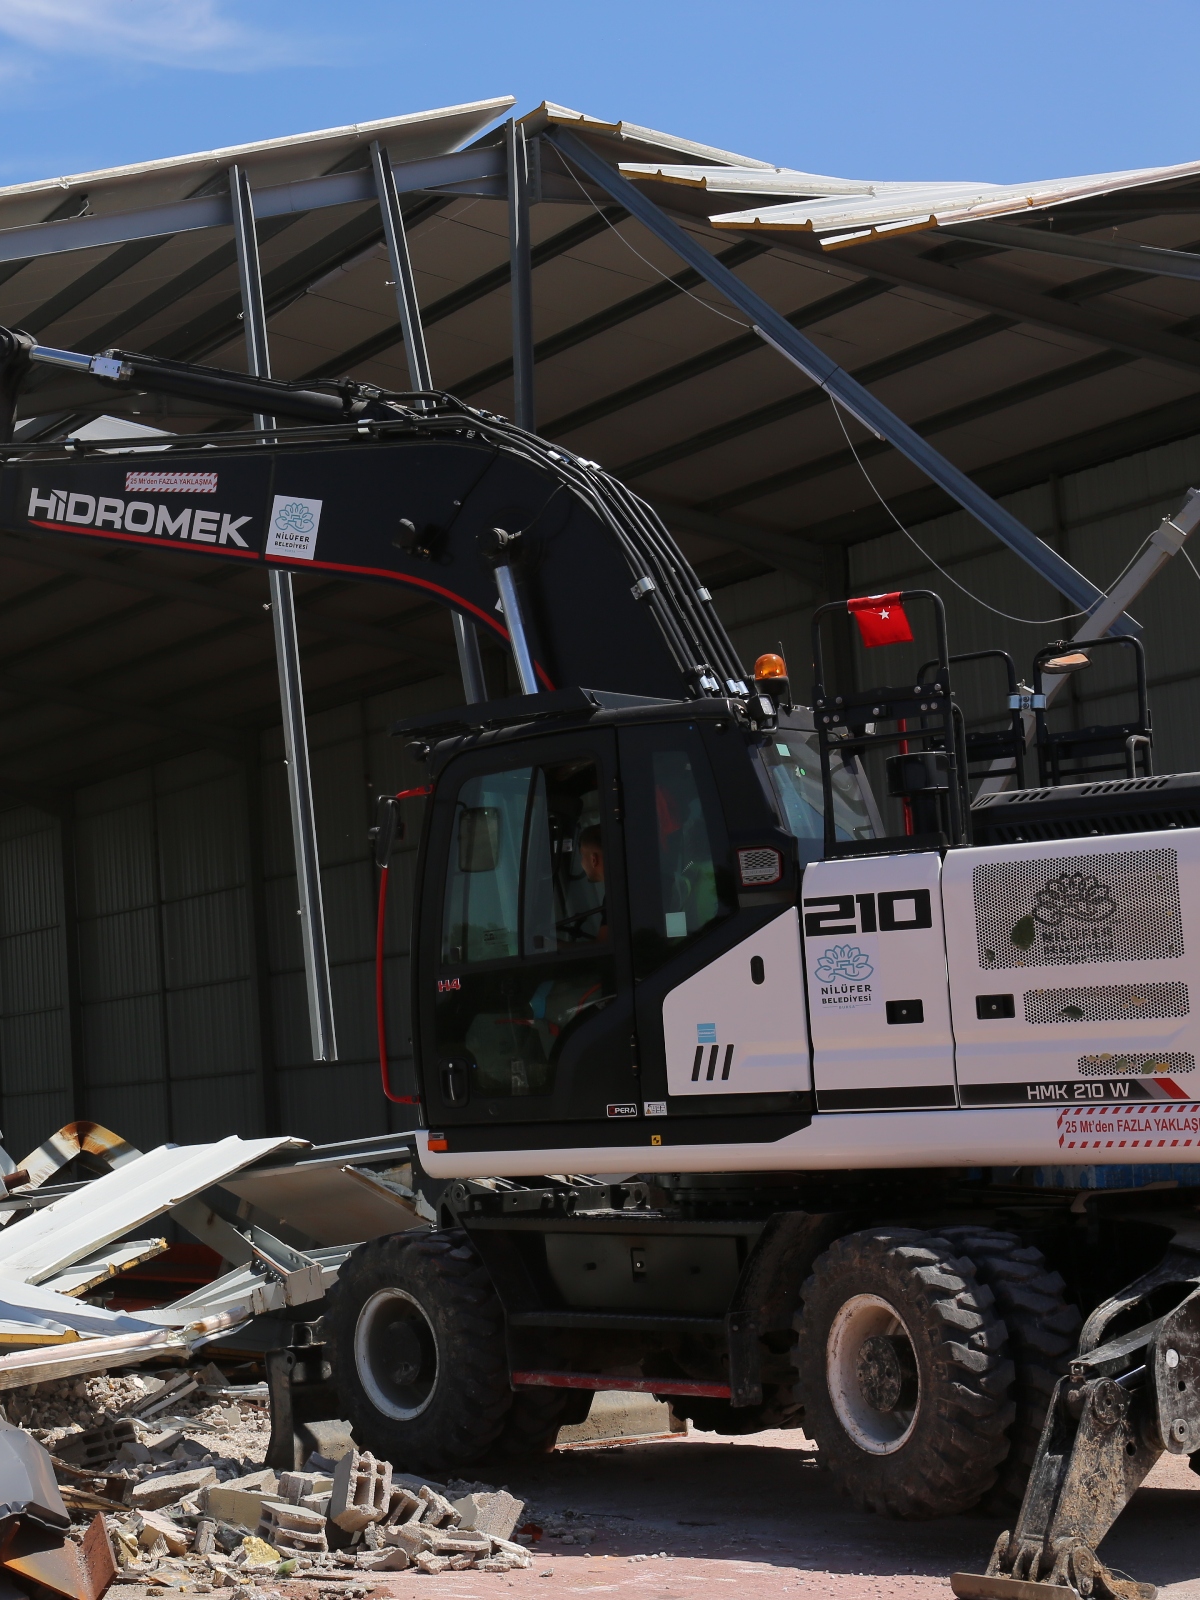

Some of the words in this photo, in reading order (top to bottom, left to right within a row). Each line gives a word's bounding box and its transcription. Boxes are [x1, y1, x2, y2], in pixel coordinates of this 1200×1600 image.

[179, 478, 213, 486] YAKLAŞMA
[275, 532, 310, 543] NİLÜFER
[274, 541, 309, 550] BELEDİYESİ
[803, 888, 933, 938] 210
[437, 978, 462, 993] H4
[820, 984, 873, 995] NİLÜFER
[821, 994, 872, 1004] BELEDİYESİ
[1026, 1084, 1069, 1100] HMK
[1073, 1083, 1104, 1099] 210
[1109, 1082, 1130, 1098] W
[1065, 1120, 1077, 1133] 25
[1079, 1119, 1114, 1133] Mt'den
[1117, 1118, 1152, 1132] FAZLA
[1153, 1117, 1200, 1134] YAKLAŞ
